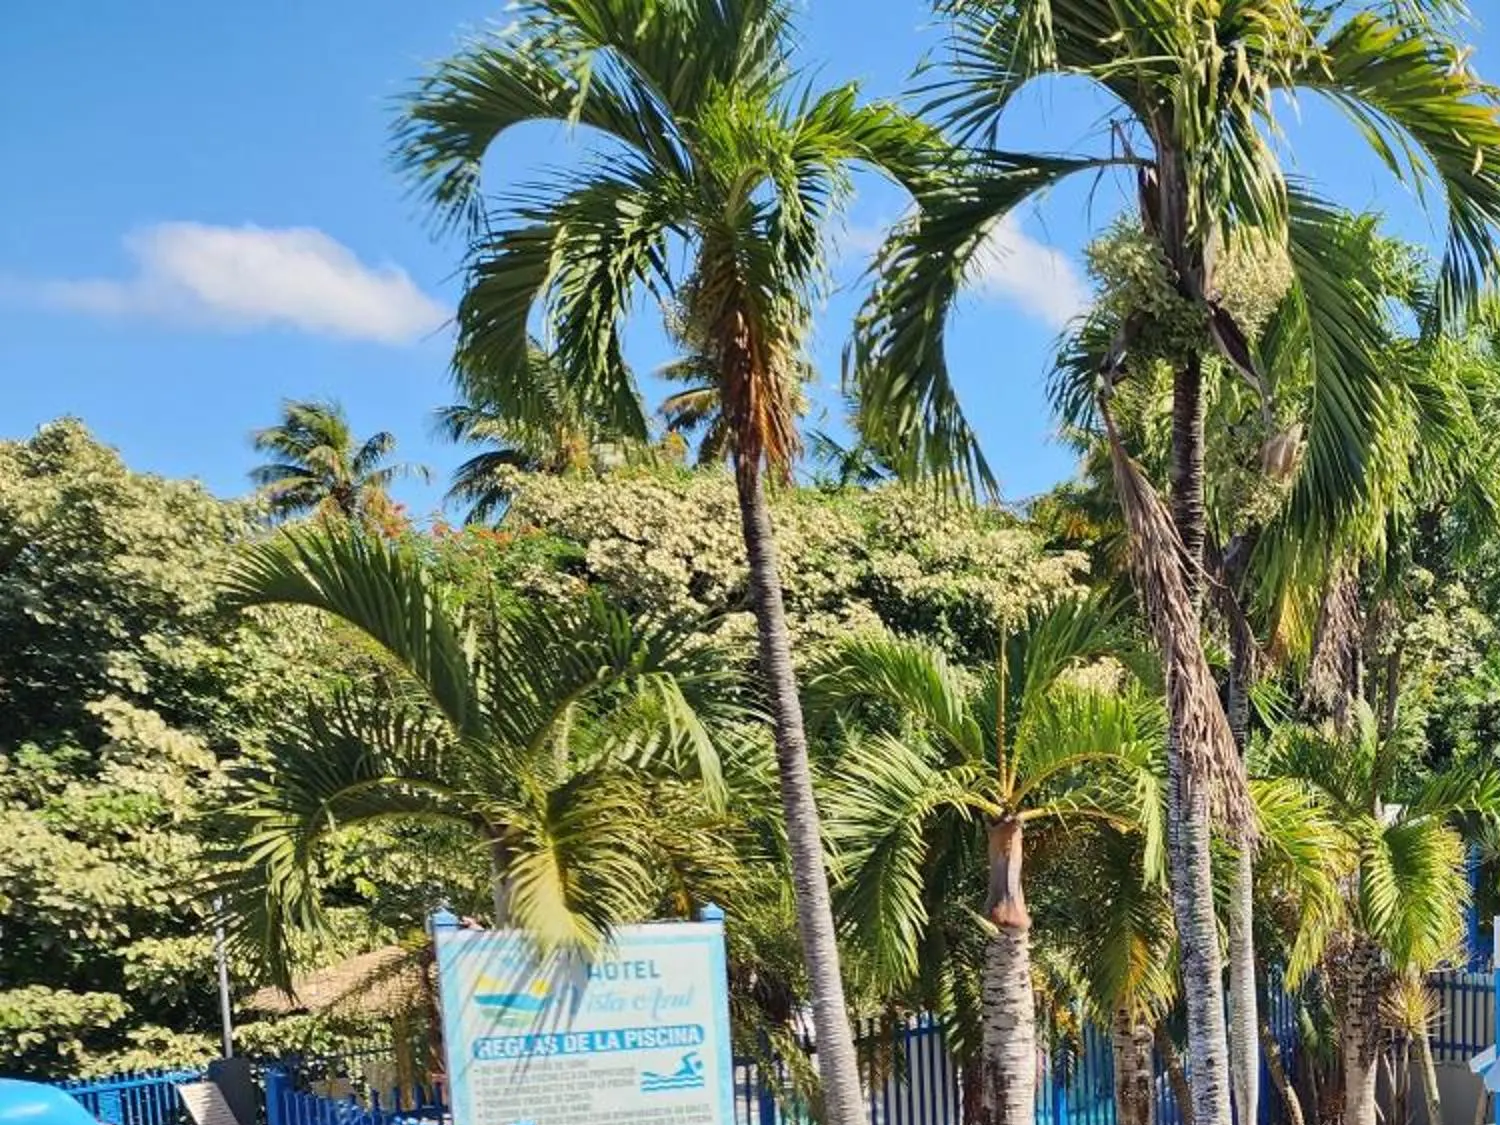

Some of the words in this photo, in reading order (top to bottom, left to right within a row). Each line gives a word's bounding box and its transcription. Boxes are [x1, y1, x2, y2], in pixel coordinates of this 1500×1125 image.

[586, 960, 662, 981] HOTEL
[478, 1034, 558, 1058] REGLAS
[563, 1033, 592, 1053] DE
[595, 1031, 620, 1050] LA
[624, 1026, 701, 1048] PISCINA
